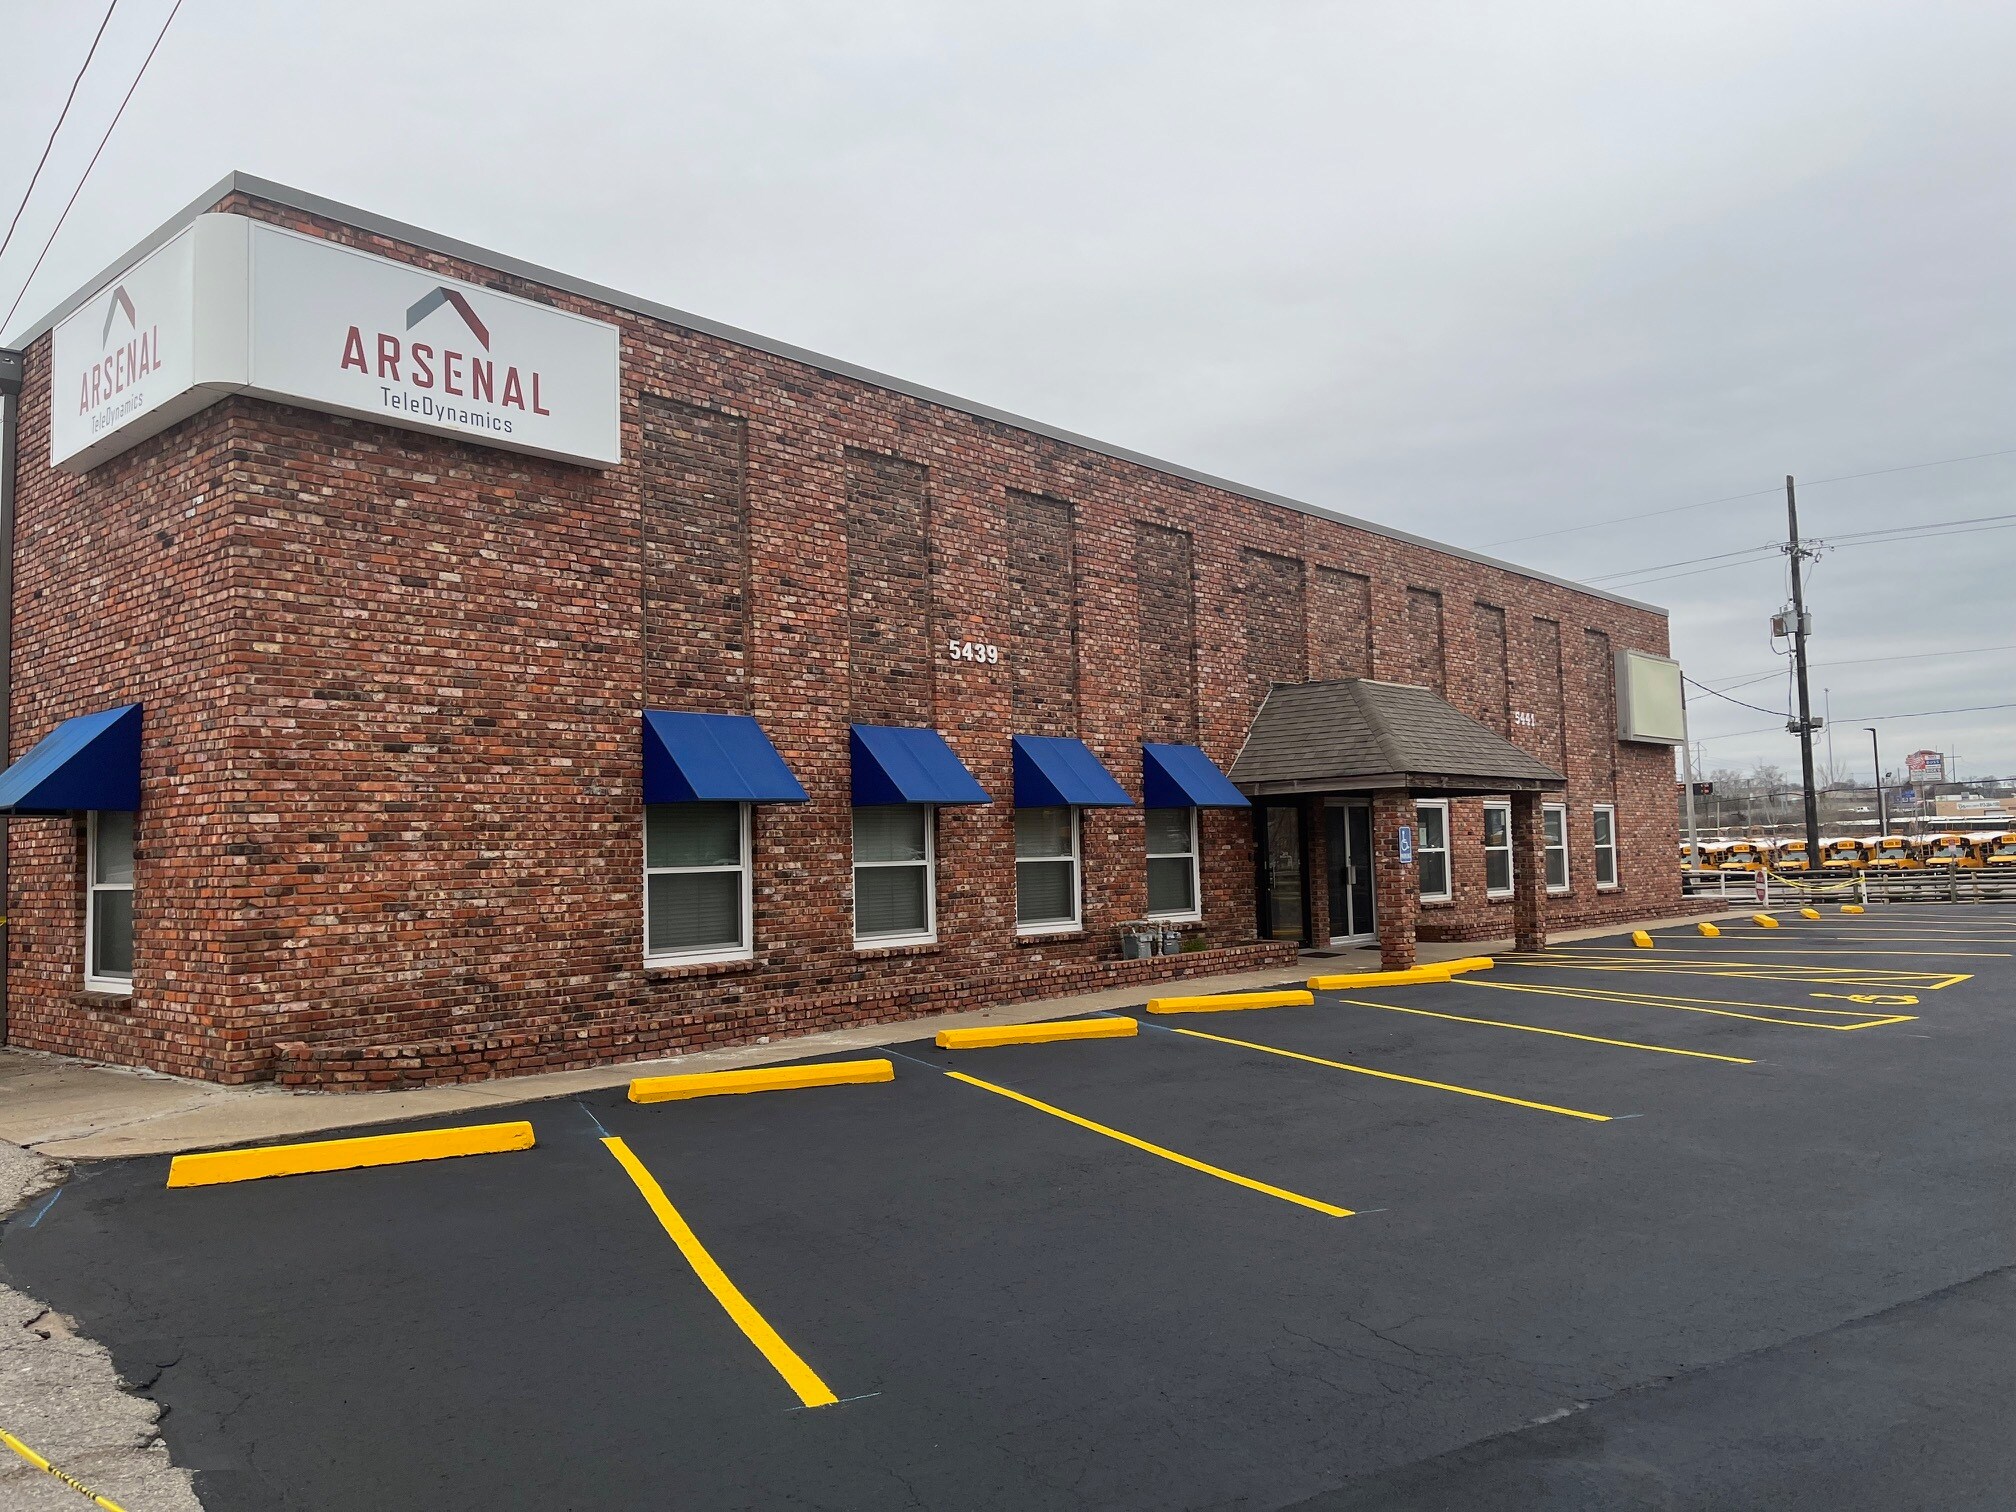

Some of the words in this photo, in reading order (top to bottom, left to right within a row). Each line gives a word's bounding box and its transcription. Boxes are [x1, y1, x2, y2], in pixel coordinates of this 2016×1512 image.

[80, 325, 161, 416] ARSENAL
[341, 326, 550, 416] ARSENAL
[92, 393, 143, 434] TeleDynamics
[381, 386, 513, 433] TeleDynamics
[949, 640, 998, 664] 5439
